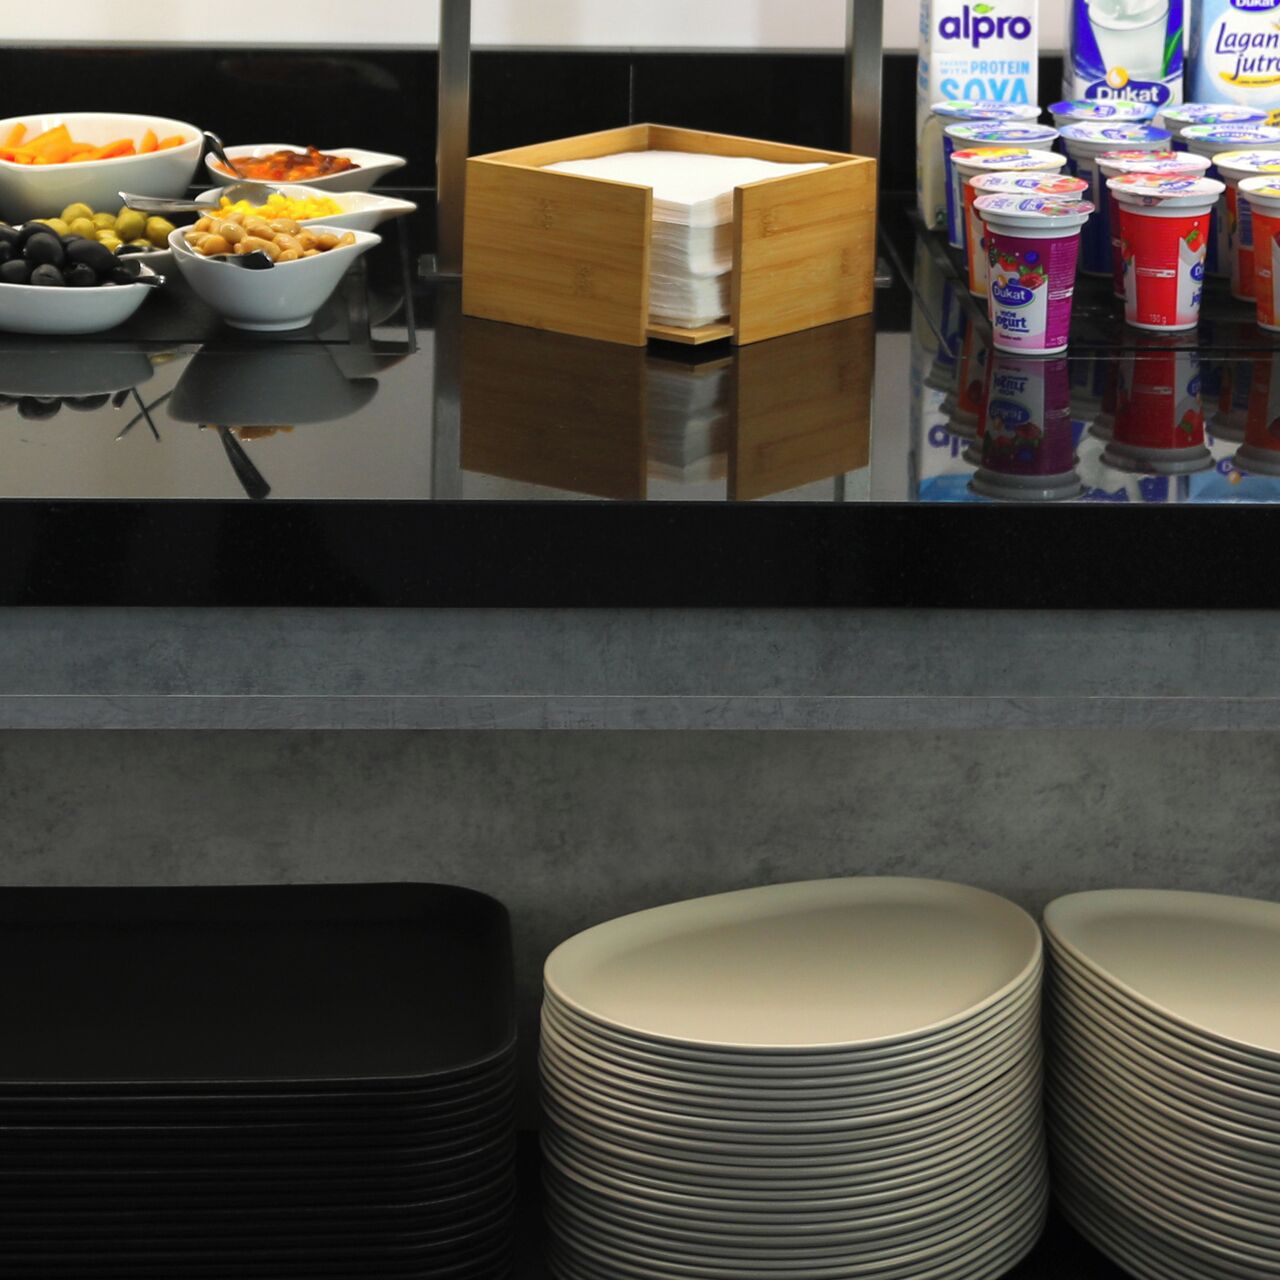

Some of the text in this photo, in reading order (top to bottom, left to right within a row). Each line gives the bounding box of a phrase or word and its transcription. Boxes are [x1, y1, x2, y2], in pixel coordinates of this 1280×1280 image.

[939, 5, 1032, 48] alpro
[970, 60, 1030, 75] PROTEIN
[940, 78, 1029, 104] SOYA
[1096, 86, 1160, 102] Dukat
[993, 286, 1026, 301] Dukat
[994, 311, 1027, 330] jogurt
